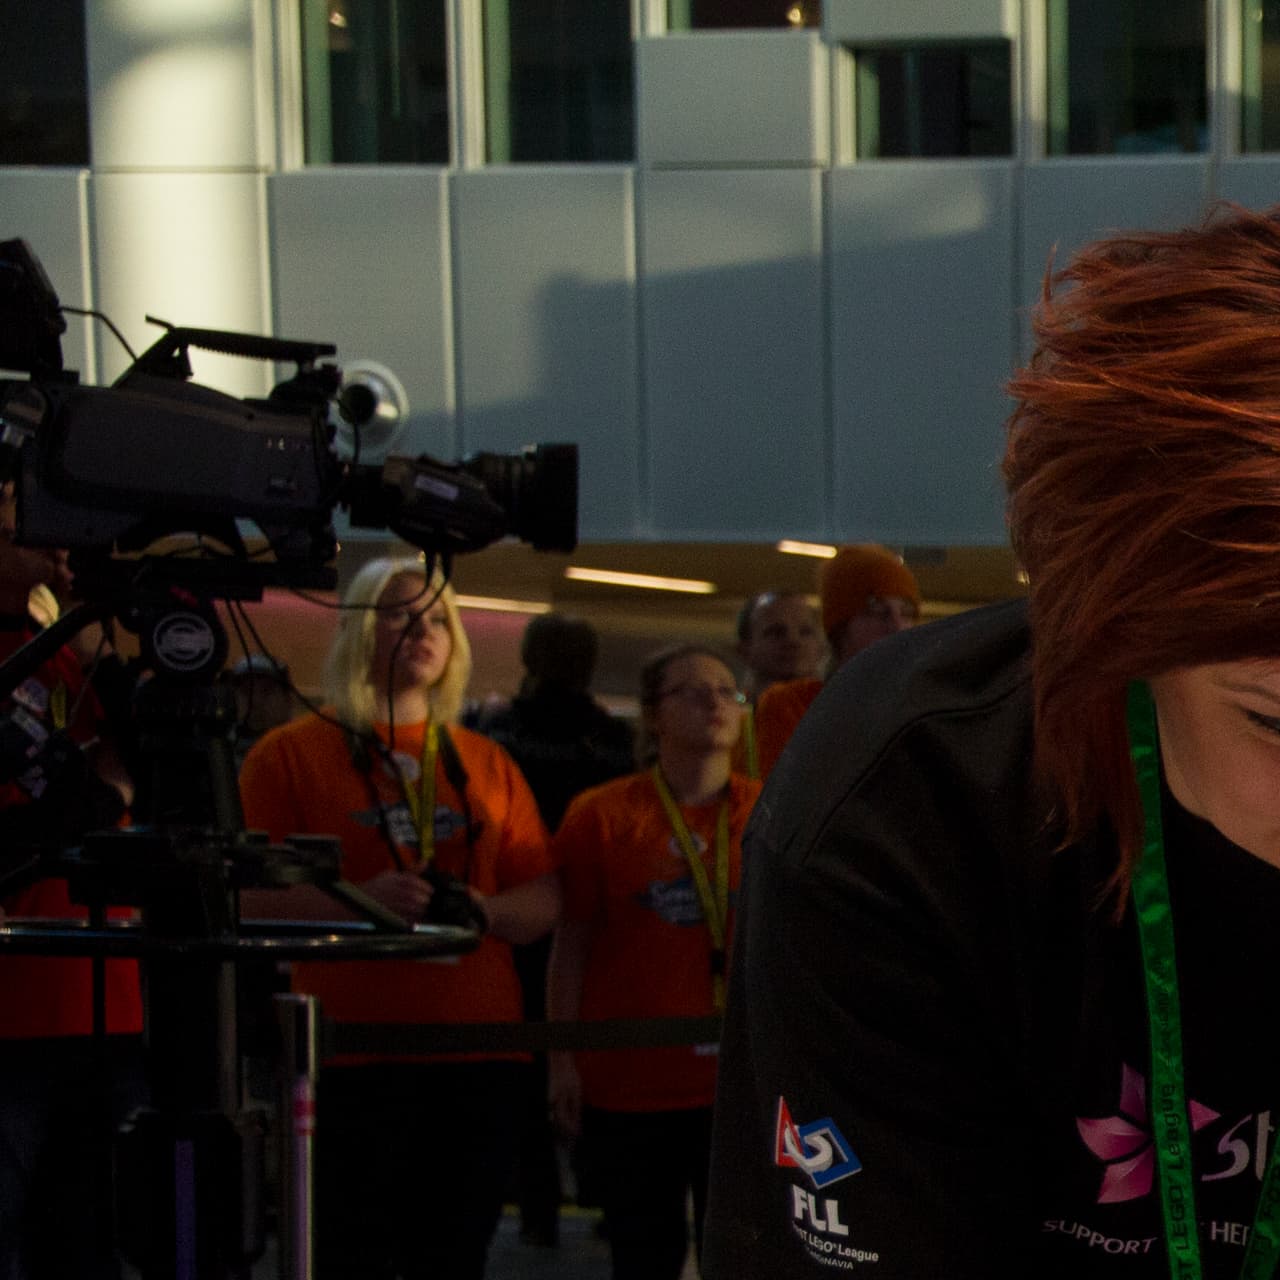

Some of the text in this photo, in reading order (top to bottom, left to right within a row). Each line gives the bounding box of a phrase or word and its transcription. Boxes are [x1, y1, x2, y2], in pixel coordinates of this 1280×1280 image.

[1162, 1083, 1185, 1170] League
[792, 1184, 849, 1236] FLL
[1040, 1219, 1159, 1256] SUPPORT
